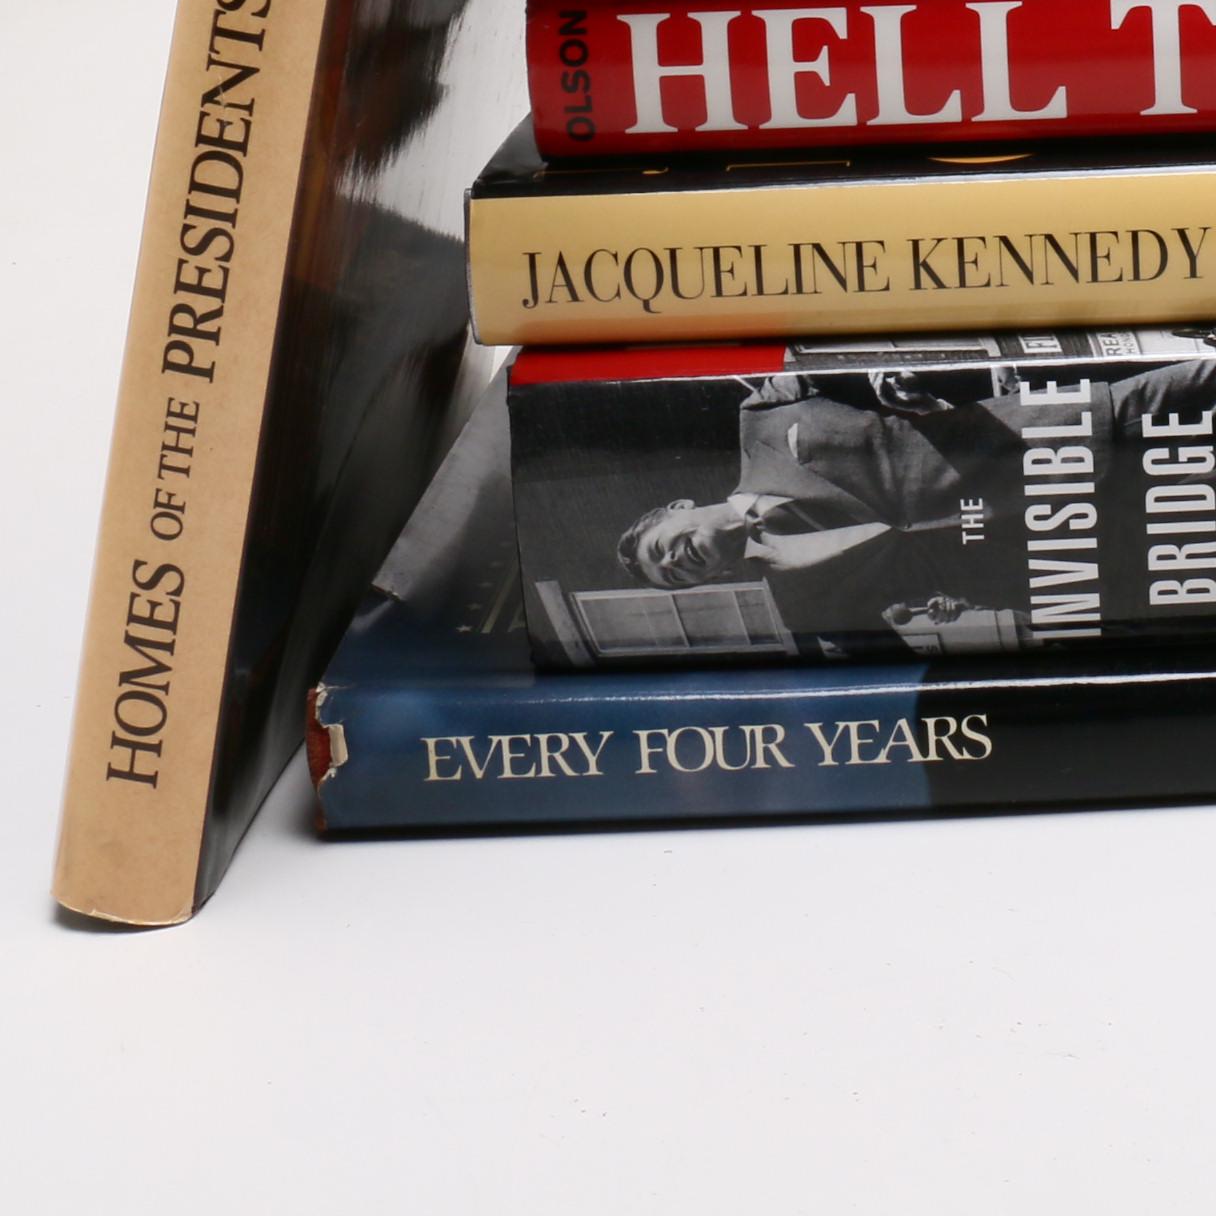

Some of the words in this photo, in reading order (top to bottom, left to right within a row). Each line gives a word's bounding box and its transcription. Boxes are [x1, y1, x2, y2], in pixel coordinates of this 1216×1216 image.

[558, 9, 596, 143] OLSON
[616, 0, 1068, 135] HELL
[521, 239, 892, 314] JACQUELINE
[907, 226, 1212, 292] KENNEDY
[157, 396, 200, 480] THE
[150, 487, 187, 542] OF
[960, 496, 985, 545] THE
[1019, 378, 1102, 640] INVISIBLE
[106, 559, 186, 790] HOMES
[420, 730, 615, 782] EVERY
[632, 723, 796, 774] FOUR
[804, 713, 994, 767] YEARS
